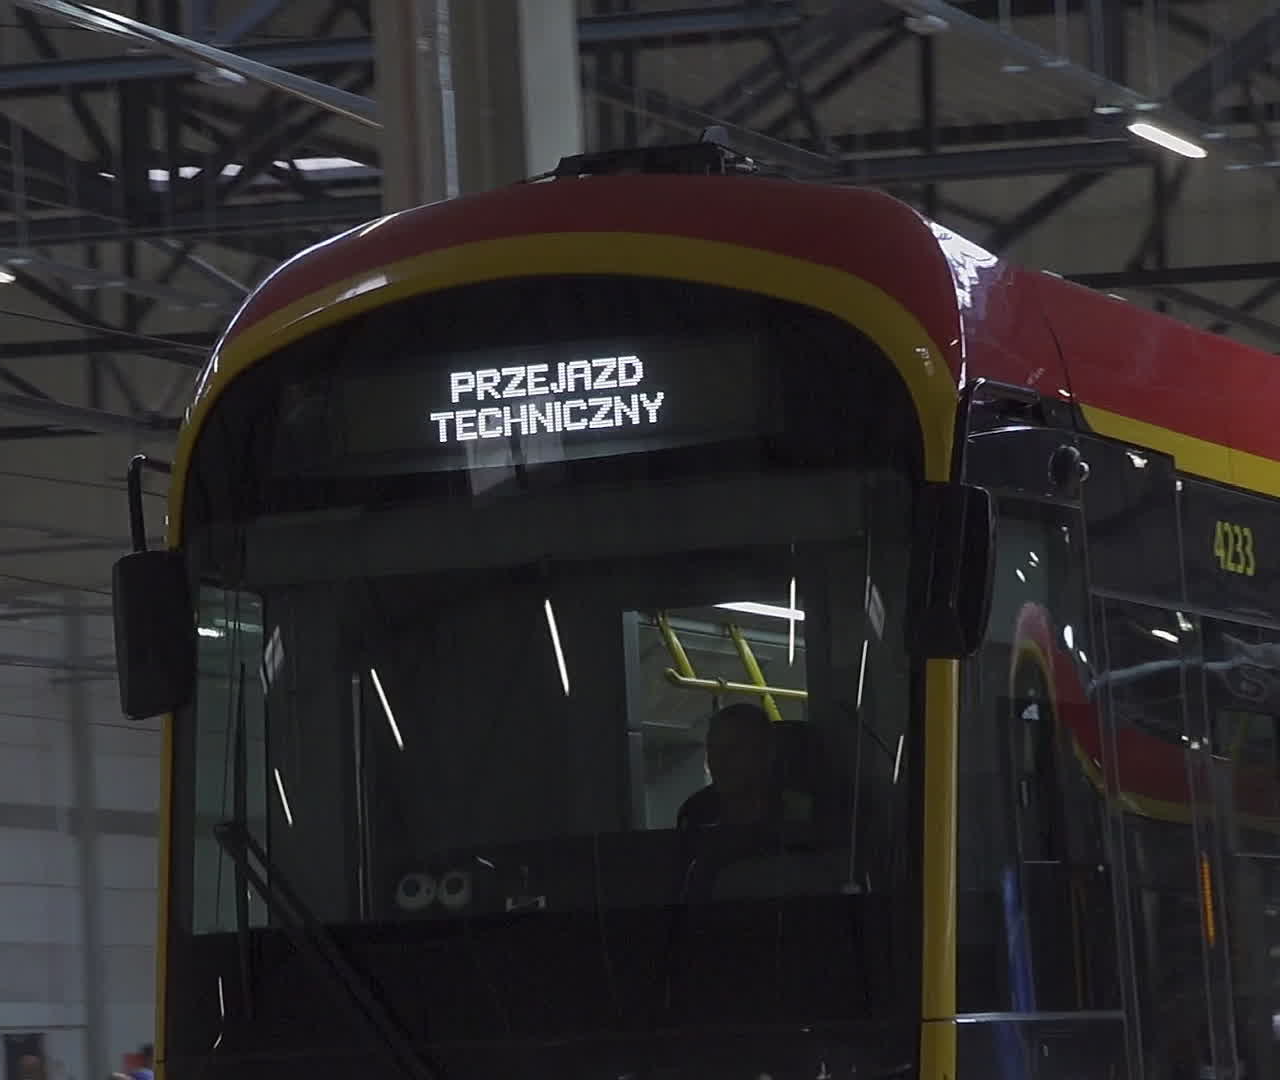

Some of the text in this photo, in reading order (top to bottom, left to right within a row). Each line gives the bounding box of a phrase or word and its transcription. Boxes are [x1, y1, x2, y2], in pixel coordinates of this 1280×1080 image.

[450, 355, 644, 403] PRZEJAZD
[430, 391, 665, 443] TECHNICZNY
[1215, 520, 1256, 577] 4233
